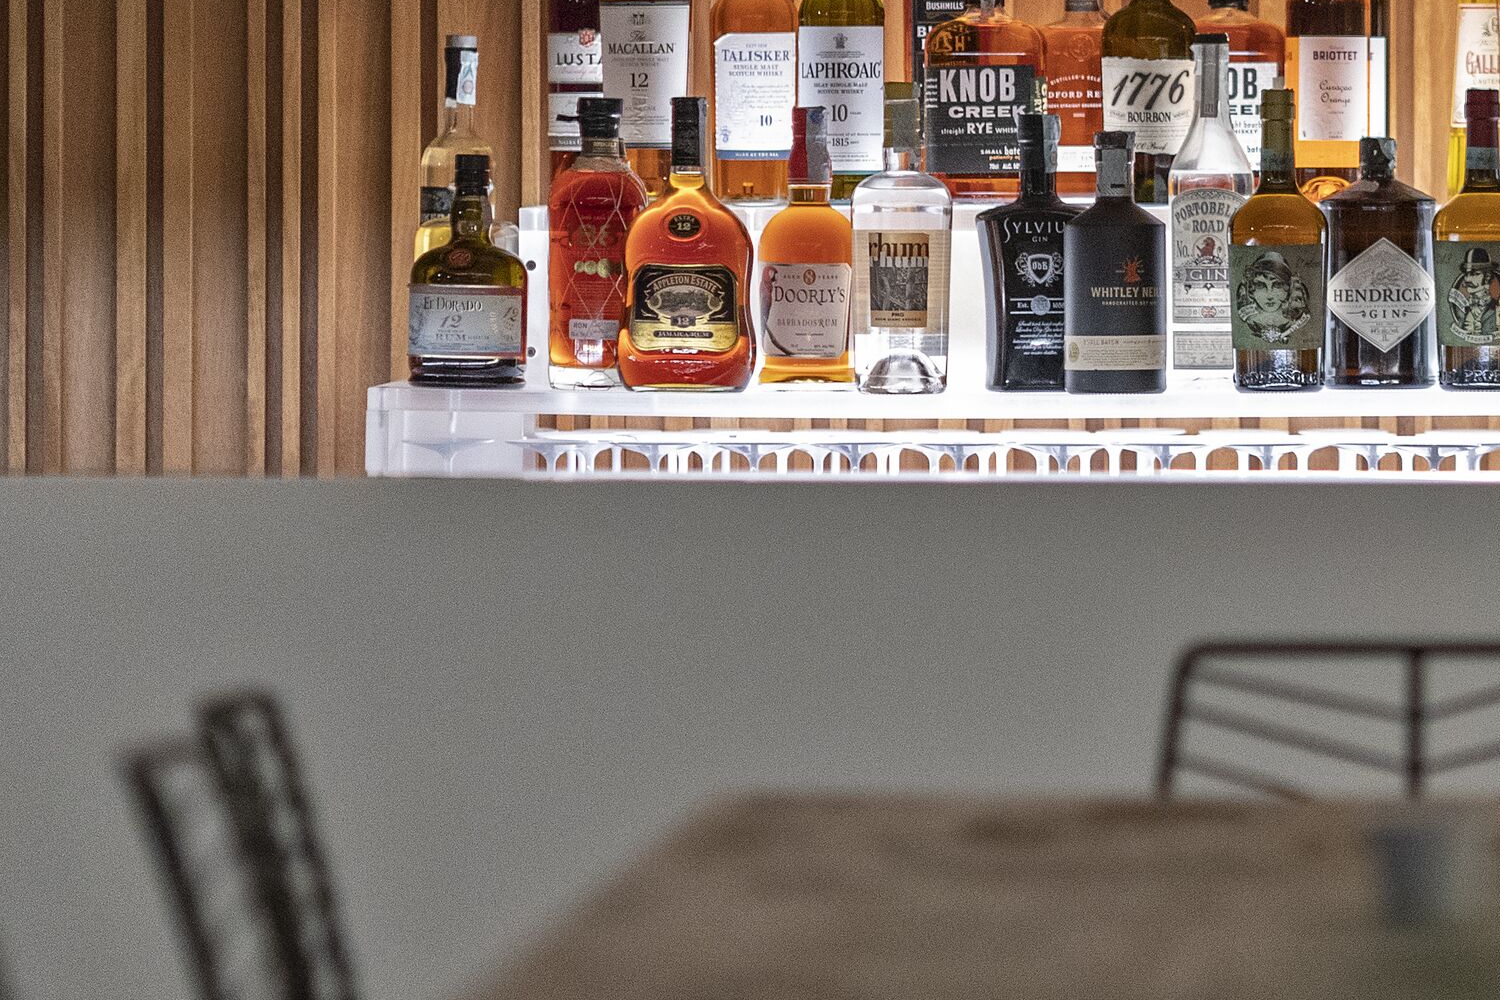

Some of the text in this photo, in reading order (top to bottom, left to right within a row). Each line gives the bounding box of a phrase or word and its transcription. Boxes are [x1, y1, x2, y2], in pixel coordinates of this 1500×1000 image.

[926, 1, 964, 10] BUSHMILLS
[608, 42, 675, 55] MACALLAN
[721, 49, 790, 62] TALISKER
[1313, 51, 1358, 60] BRIOTTET
[801, 61, 881, 79] LAPHROAIG
[630, 73, 649, 88] 12
[940, 68, 1015, 103] KNOB
[1111, 70, 1190, 110] 1776
[831, 104, 848, 122] 10
[948, 105, 1026, 118] CREEK
[1127, 111, 1172, 123] BOURBON
[760, 114, 773, 127] 10
[941, 127, 965, 136] straight
[967, 122, 993, 134] RYE
[832, 138, 849, 147] 1815
[674, 214, 695, 223] EXTRA
[677, 222, 691, 231] 12
[1192, 220, 1225, 233] ROAD
[869, 233, 929, 262] rhum
[1189, 269, 1227, 280] GIN
[653, 275, 717, 293] APPLETON ESTATE
[774, 286, 846, 305] DOORLY'S
[1091, 286, 1139, 298] WHITLEY
[1333, 287, 1430, 303] HENDRICK'S
[437, 296, 483, 312] DORADO
[1369, 309, 1401, 319] GIN
[440, 314, 462, 328] 12
[677, 317, 690, 325] 12
[777, 318, 838, 328] BARBADOS RUM
